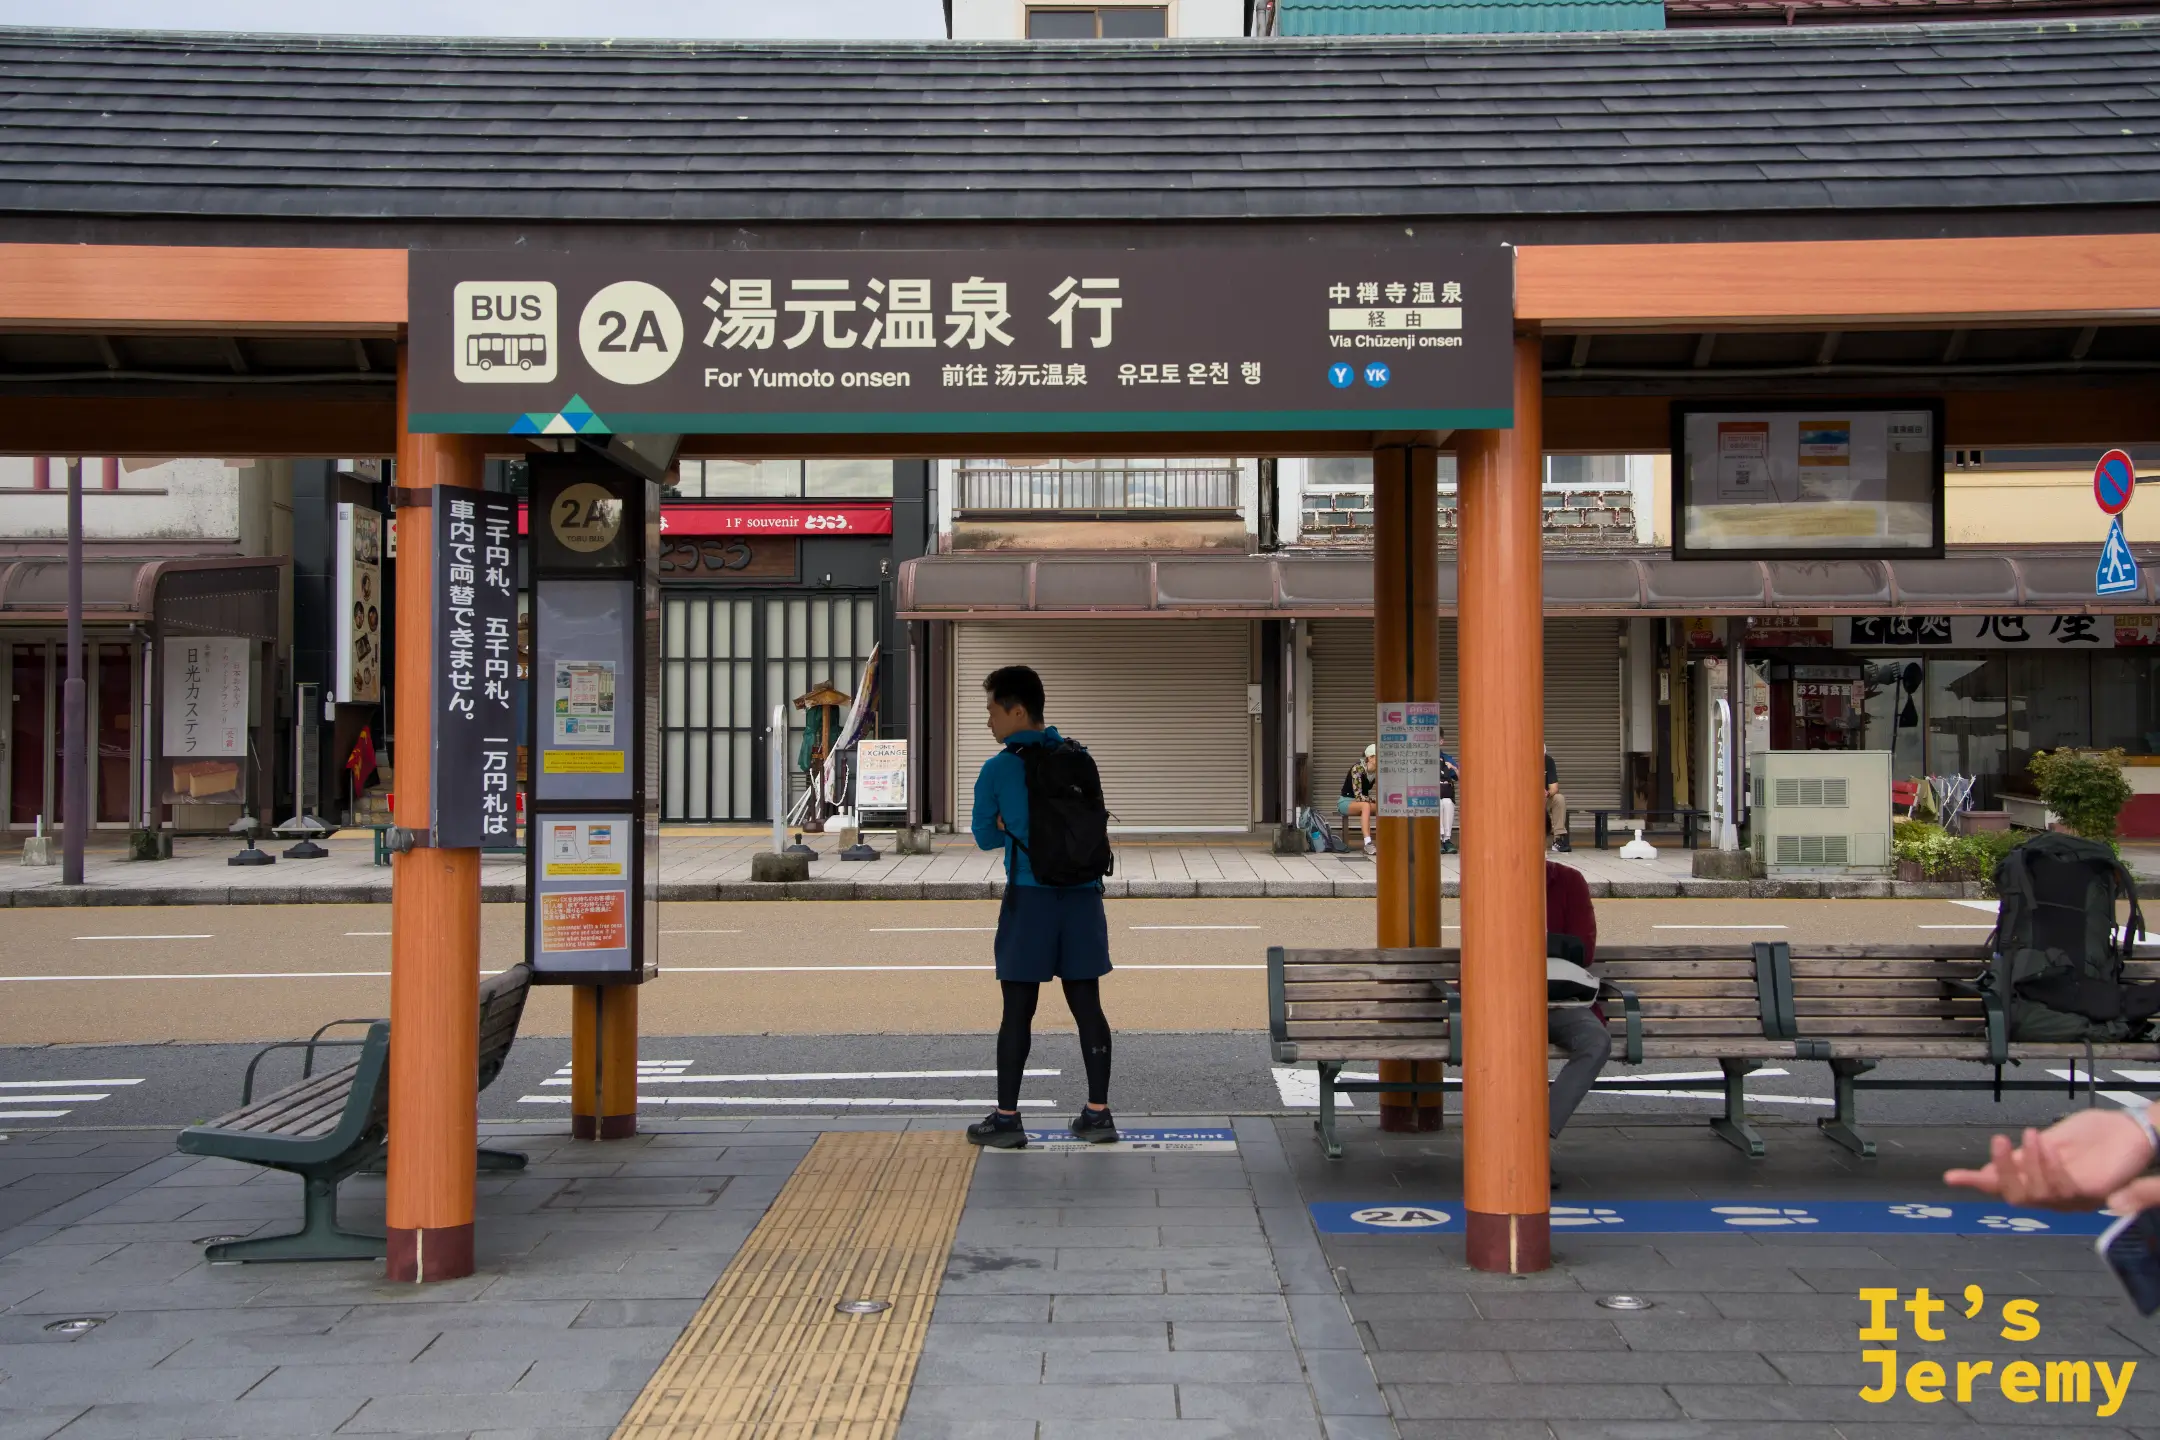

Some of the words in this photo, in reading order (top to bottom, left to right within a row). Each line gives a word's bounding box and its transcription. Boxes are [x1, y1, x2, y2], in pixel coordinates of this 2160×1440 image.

[1328, 281, 1463, 305] 中禅寺温泉
[470, 295, 542, 322] BUS
[702, 276, 1015, 350] 湯元温泉
[1047, 277, 1122, 349] 行
[596, 310, 669, 353] 2A
[1329, 335, 1352, 348] Via
[1355, 334, 1415, 350] Chūzenji
[1418, 335, 1463, 347] onsen
[704, 368, 742, 387] For
[748, 367, 835, 387] Yumoto
[840, 371, 911, 387] onsen
[941, 363, 988, 387] 前往
[994, 363, 1088, 387] 汤元温泉
[1117, 363, 1182, 386] 유모토
[1187, 362, 1229, 386] 온천
[1240, 361, 1262, 386] 행
[1334, 367, 1348, 384] Y
[1366, 368, 1387, 382] YK
[561, 499, 611, 528] 2A
[747, 517, 800, 528] souvenir
[485, 504, 511, 597] 二千円札、
[448, 499, 476, 720] 車内で両替できません。
[484, 617, 511, 709] 五千円札、
[184, 648, 201, 753] 日光カステラ
[483, 737, 509, 835] 一万円札は
[1163, 1132, 1225, 1140] Point
[1361, 1210, 1440, 1222] 2A
